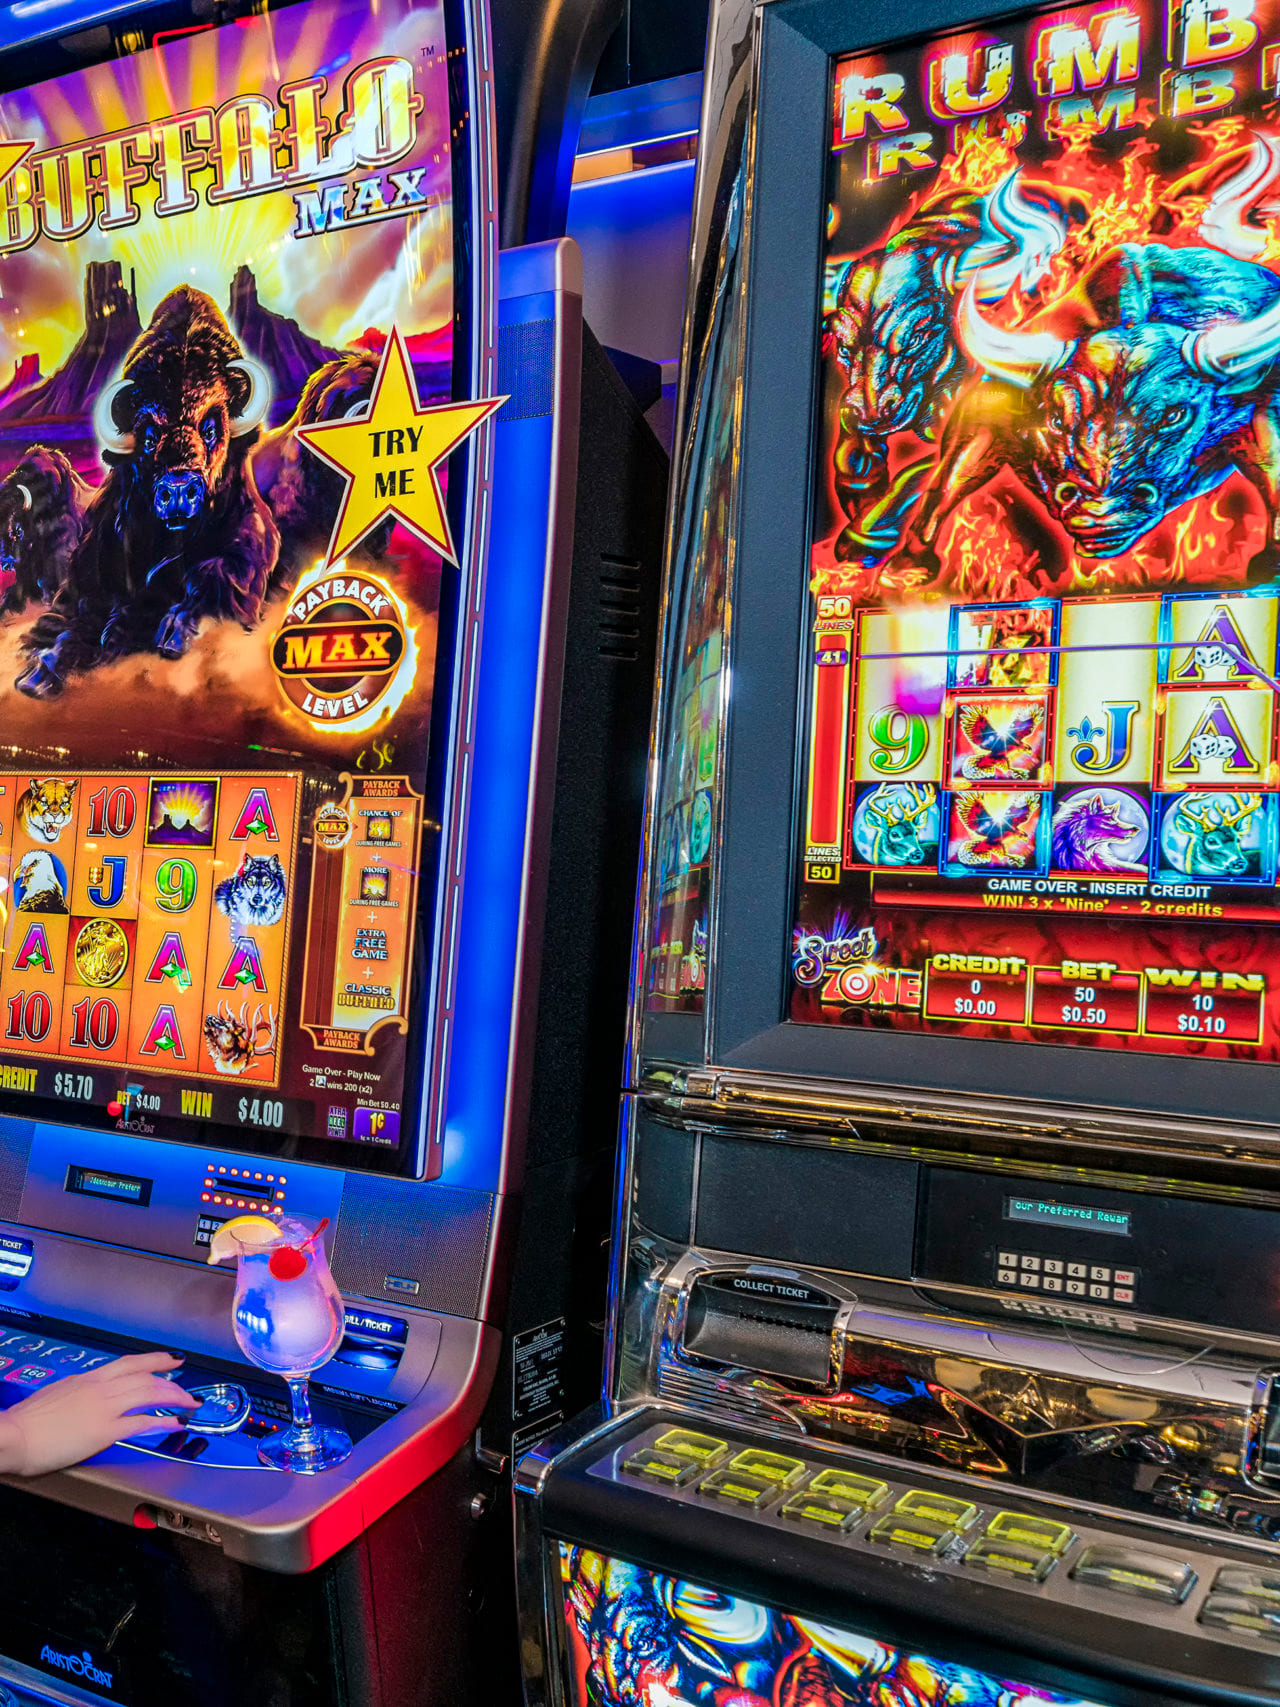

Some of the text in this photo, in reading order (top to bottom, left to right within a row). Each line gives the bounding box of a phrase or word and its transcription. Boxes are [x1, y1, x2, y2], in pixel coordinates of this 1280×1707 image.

[293, 167, 427, 239] MAX
[368, 425, 424, 457] TRY
[375, 468, 415, 498] ME
[293, 579, 391, 620] PAYBACK
[818, 597, 851, 619] 50
[815, 620, 854, 630] LINES
[282, 631, 393, 669] MAX
[821, 651, 841, 664] 41
[301, 691, 368, 717] LEVEL
[868, 706, 930, 774] 9
[1071, 700, 1140, 775] J
[363, 781, 400, 789] PAYBACK
[363, 788, 398, 797] AWARDS
[87, 786, 137, 837] 10
[229, 787, 280, 842] A
[318, 822, 346, 832] MAX
[807, 847, 839, 857] LINES
[87, 856, 128, 908] J
[811, 866, 832, 879] 50
[155, 858, 197, 913] 9
[987, 878, 1032, 892] GAME
[1035, 880, 1078, 894] OVER
[1089, 882, 1147, 897] INSERT
[1150, 884, 1211, 899] CREDIT
[982, 894, 1024, 908] WIN!
[1029, 896, 1039, 909] 3
[1043, 899, 1053, 909] x
[1060, 898, 1109, 911] 'Nine'
[1141, 900, 1150, 913] 2
[1155, 902, 1223, 917] credits
[354, 938, 386, 949] FREE
[356, 928, 386, 938] EXTRA
[12, 922, 55, 973] A
[145, 931, 192, 986] A
[351, 949, 388, 960] GAME
[217, 936, 268, 993] A
[932, 954, 1027, 976] CREDIT
[1061, 960, 1117, 982] BET
[344, 983, 391, 995] CLASSIC
[821, 964, 922, 1008] ZONE
[971, 980, 980, 995] 0
[1145, 968, 1264, 991] WIN
[1074, 987, 1095, 1003] 50
[1192, 995, 1213, 1012] 10
[6, 990, 53, 1043] 10
[955, 998, 997, 1017] $0.00
[1061, 1006, 1107, 1025] $0.50
[70, 996, 119, 1051] 10
[139, 1004, 187, 1060] A
[1178, 1014, 1226, 1034] $0.10
[323, 1029, 360, 1041] PAYBACK
[323, 1038, 358, 1049] AWARDS
[302, 1064, 323, 1074] Game
[324, 1067, 341, 1077] Over
[347, 1069, 363, 1081] Play
[364, 1072, 381, 1081] Now
[54, 1071, 94, 1100] $5.70
[309, 1078, 373, 1095] 2 wins 200 (x2)
[116, 1090, 131, 1106] BET
[136, 1094, 161, 1111] $4.00
[181, 1089, 213, 1118] WIN
[238, 1097, 283, 1128] $4.00
[1038, 1203, 1093, 1220] Preferred
[1097, 1211, 1129, 1224] Rewar
[2, 1239, 24, 1251] TICKET
[1004, 1255, 1010, 1264] 1
[1026, 1258, 1034, 1268] 2
[1049, 1262, 1056, 1272] 3
[1072, 1266, 1079, 1275] 4
[1096, 1269, 1103, 1279] 5
[733, 1279, 810, 1299] COLLECT TICKET
[1002, 1272, 1009, 1282] 6
[1025, 1276, 1032, 1285] 7
[1048, 1279, 1055, 1289] 8
[1071, 1283, 1078, 1293] 9
[1095, 1287, 1102, 1297] 0
[23, 1367, 47, 1378] 160
[40, 1645, 113, 1688] ARISTOCRAT
